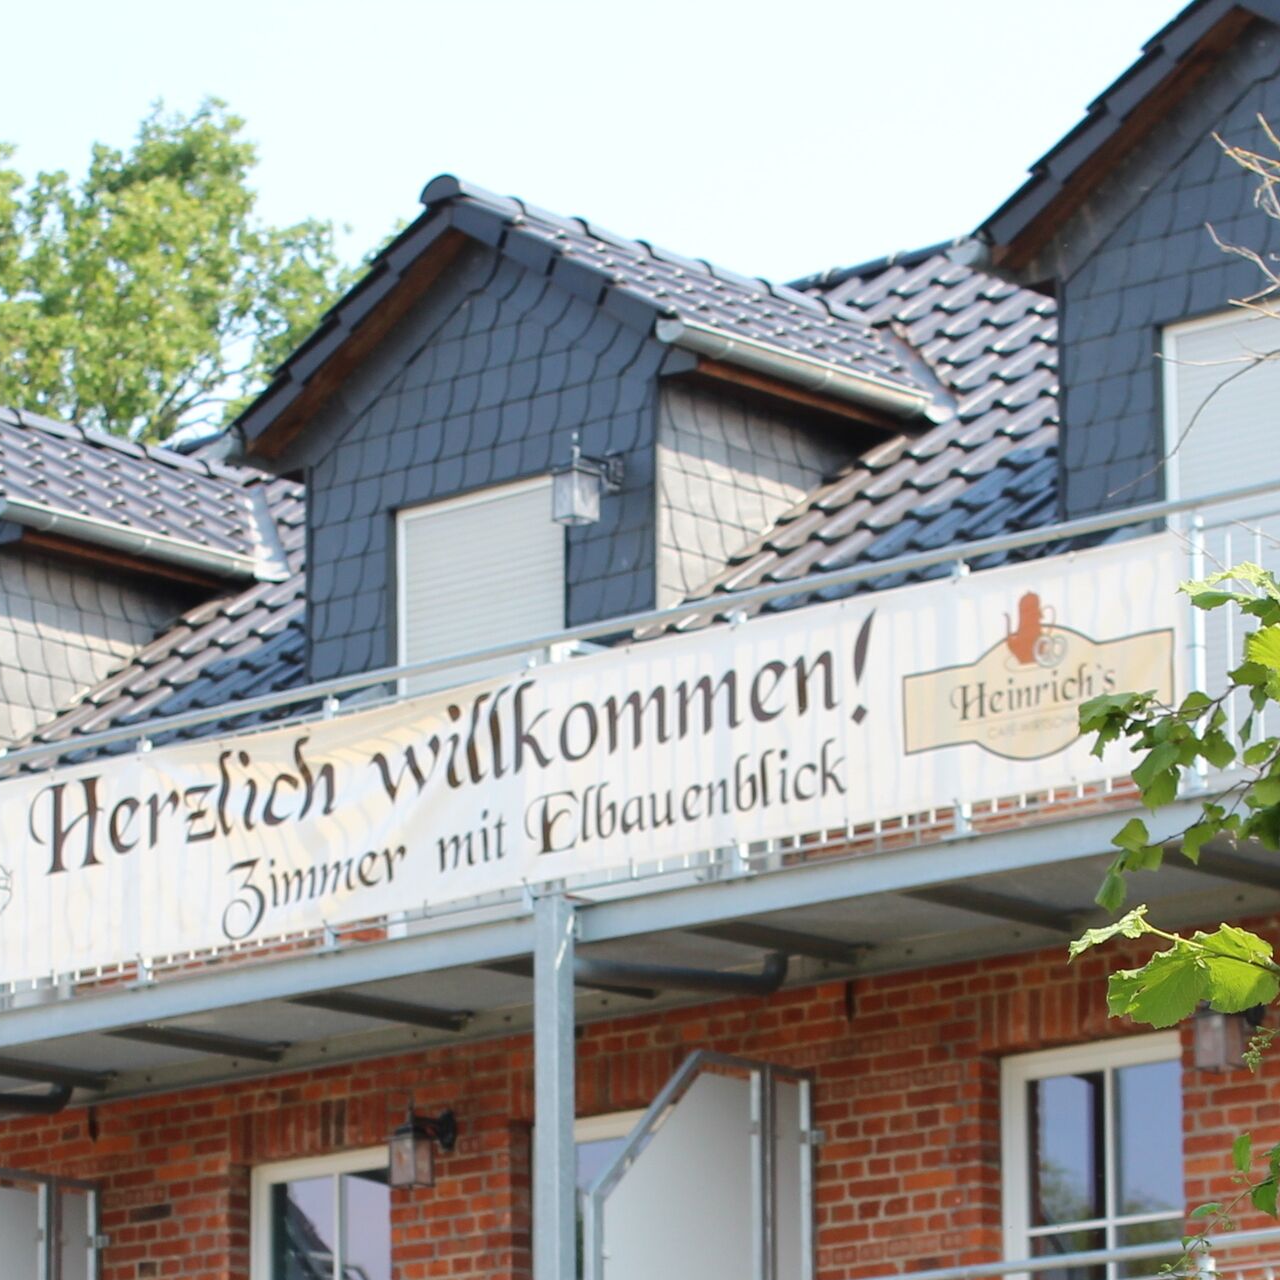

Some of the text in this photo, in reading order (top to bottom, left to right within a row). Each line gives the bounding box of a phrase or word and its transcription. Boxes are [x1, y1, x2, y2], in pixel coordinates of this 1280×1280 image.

[29, 607, 876, 875] Herzlich willkommen!
[223, 738, 847, 940] Zimmer mit Elbauenblick
